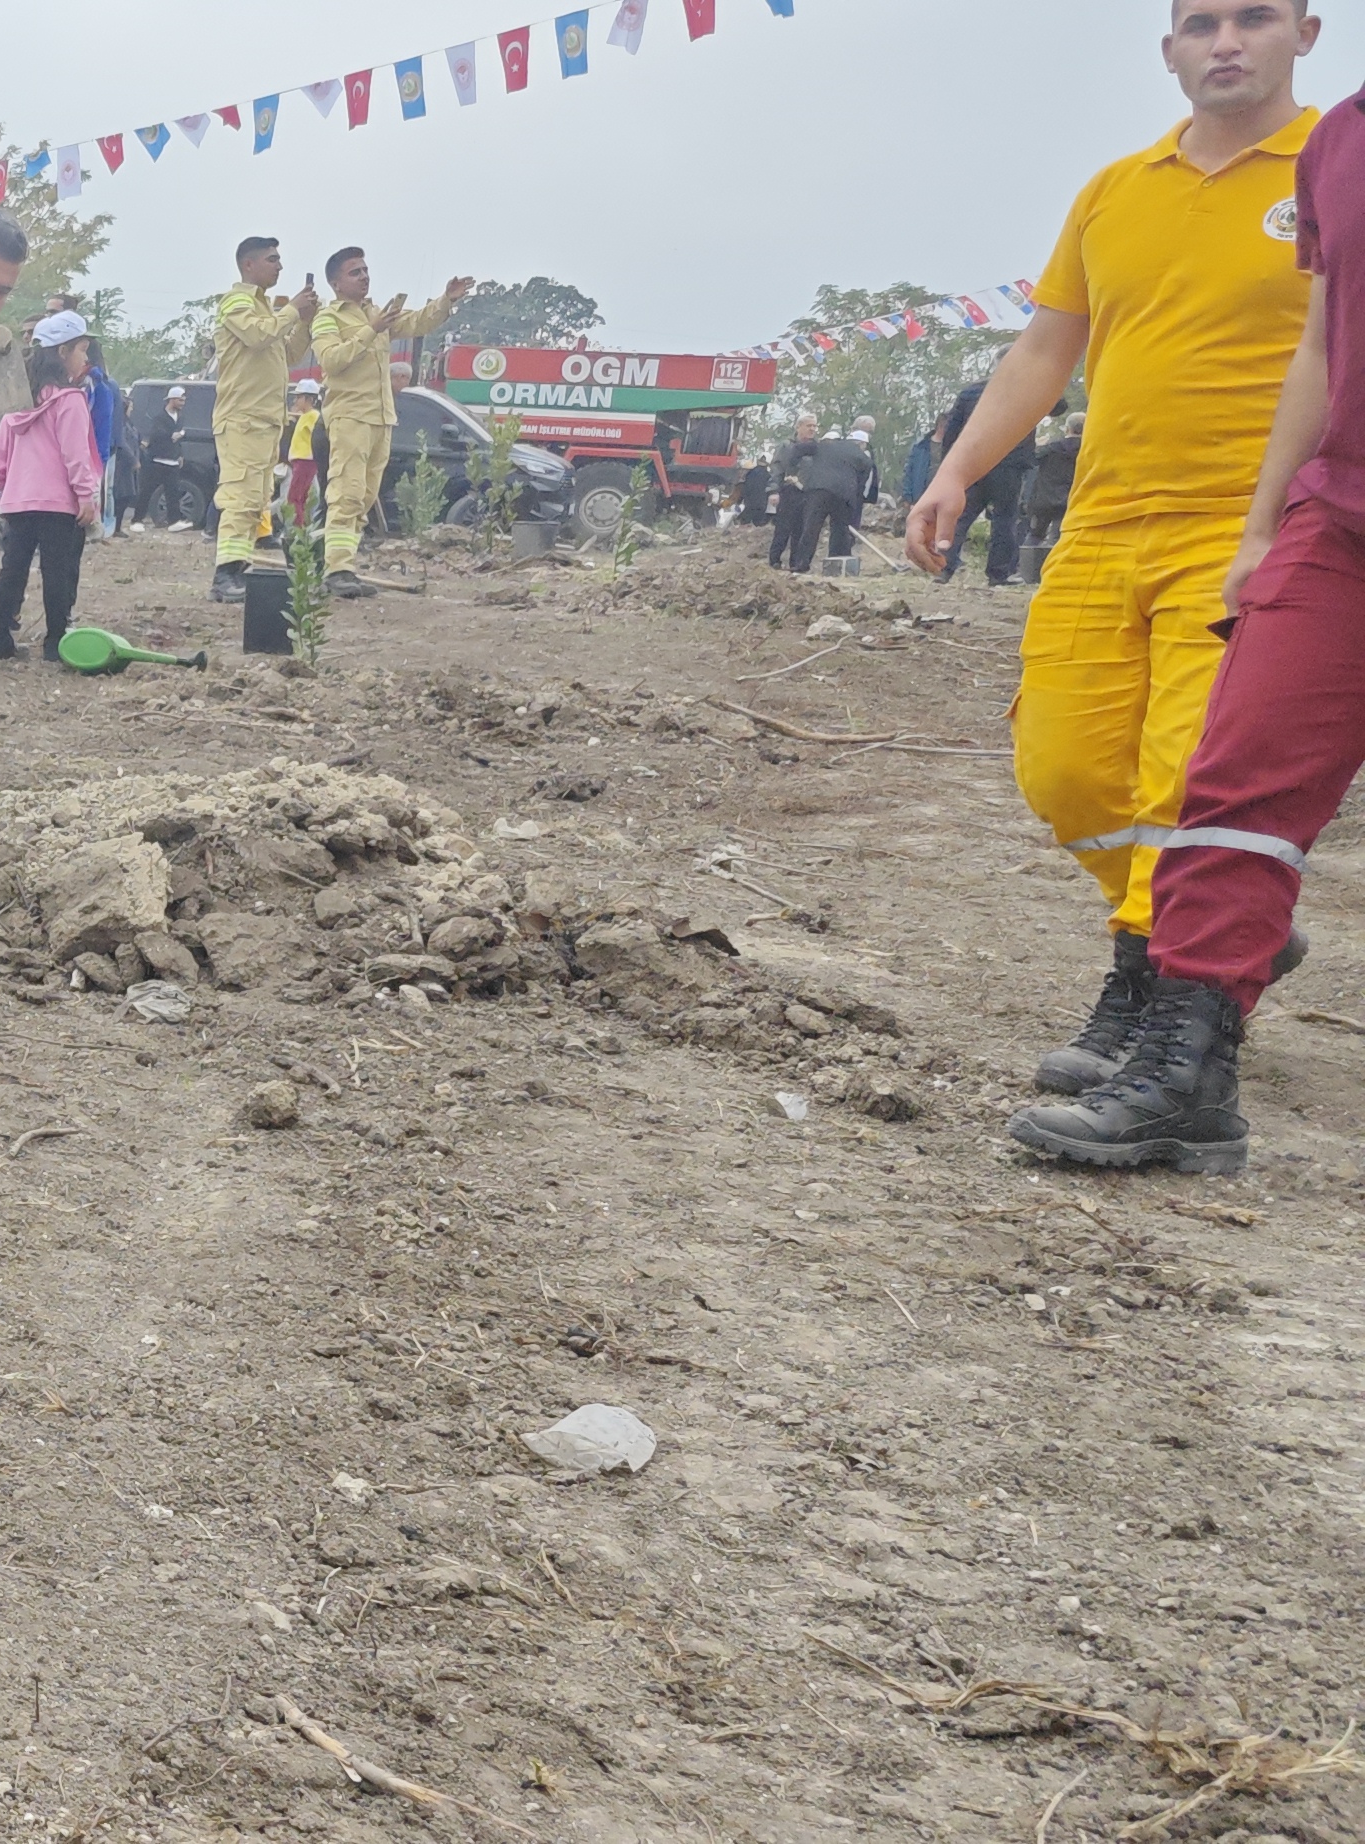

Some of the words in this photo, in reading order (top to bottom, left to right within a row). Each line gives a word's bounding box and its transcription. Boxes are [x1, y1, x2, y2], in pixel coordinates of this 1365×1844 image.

[561, 354, 660, 387] OGM
[719, 362, 743, 378] 112
[489, 382, 613, 409] ORMAN
